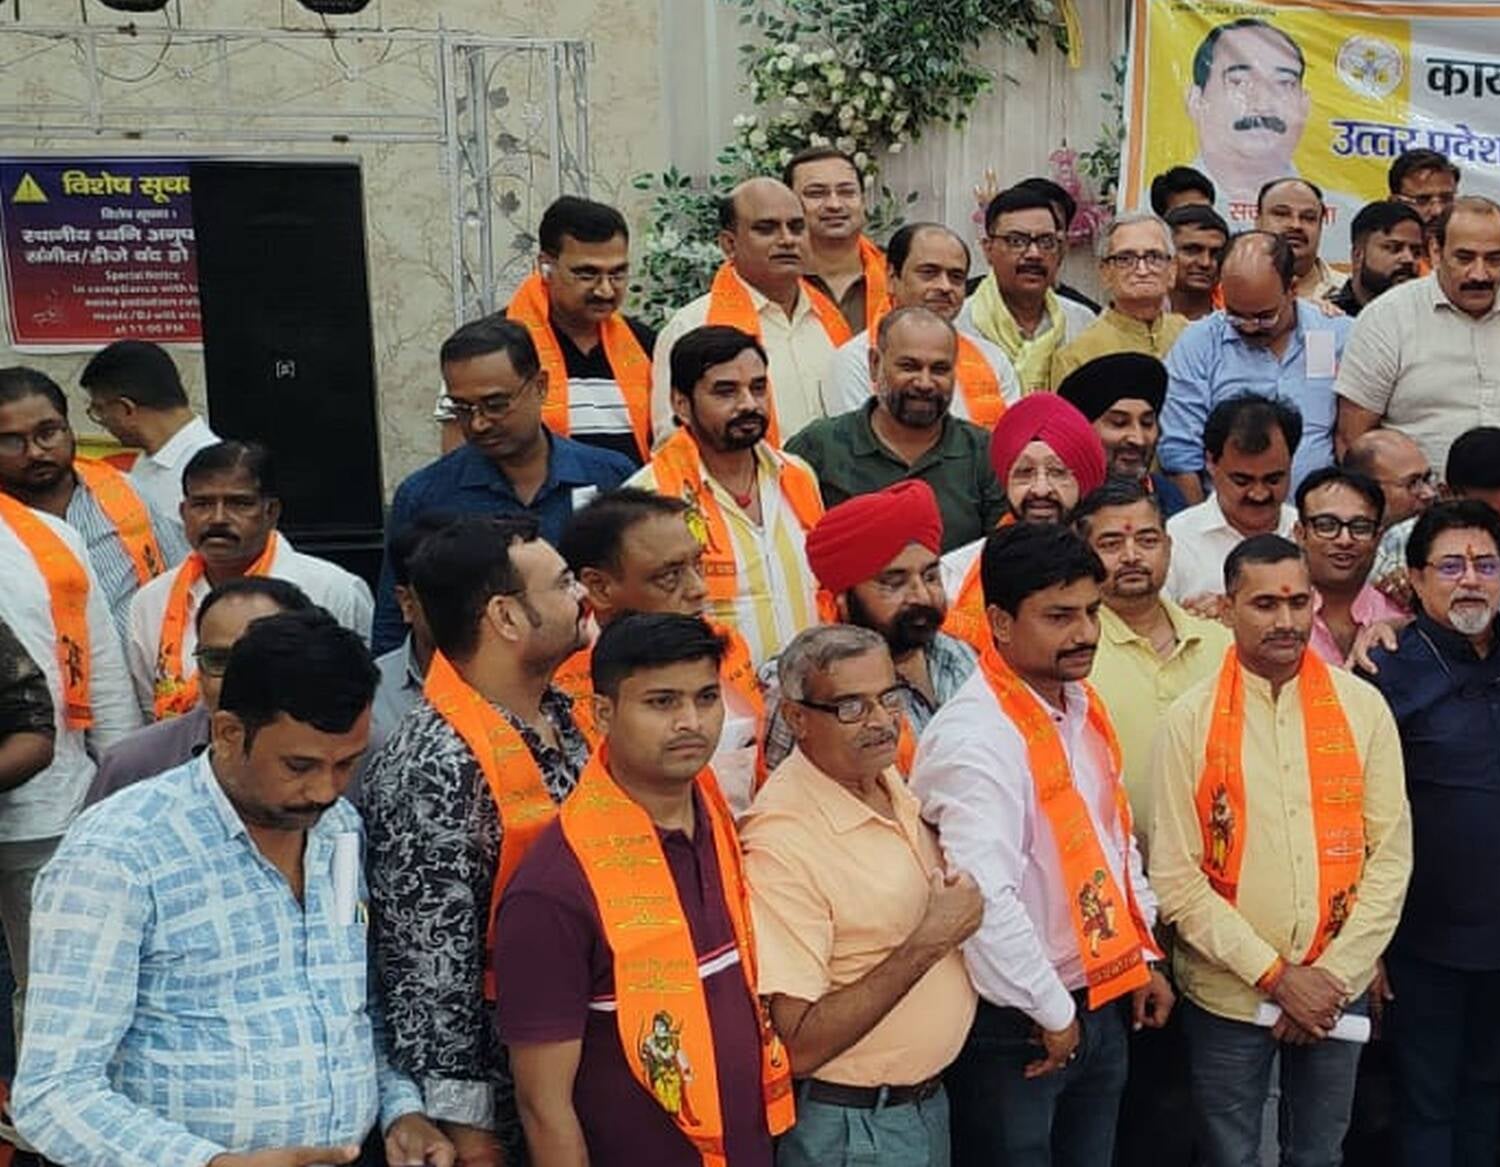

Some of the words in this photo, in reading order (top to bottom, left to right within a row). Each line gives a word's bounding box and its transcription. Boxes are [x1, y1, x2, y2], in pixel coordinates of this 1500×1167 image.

[1333, 121, 1416, 157] उत्तर
[62, 171, 132, 195] विशेष
[21, 225, 91, 243] स्थानीय
[97, 224, 141, 242] ध्वनि
[148, 228, 195, 247] अनुप
